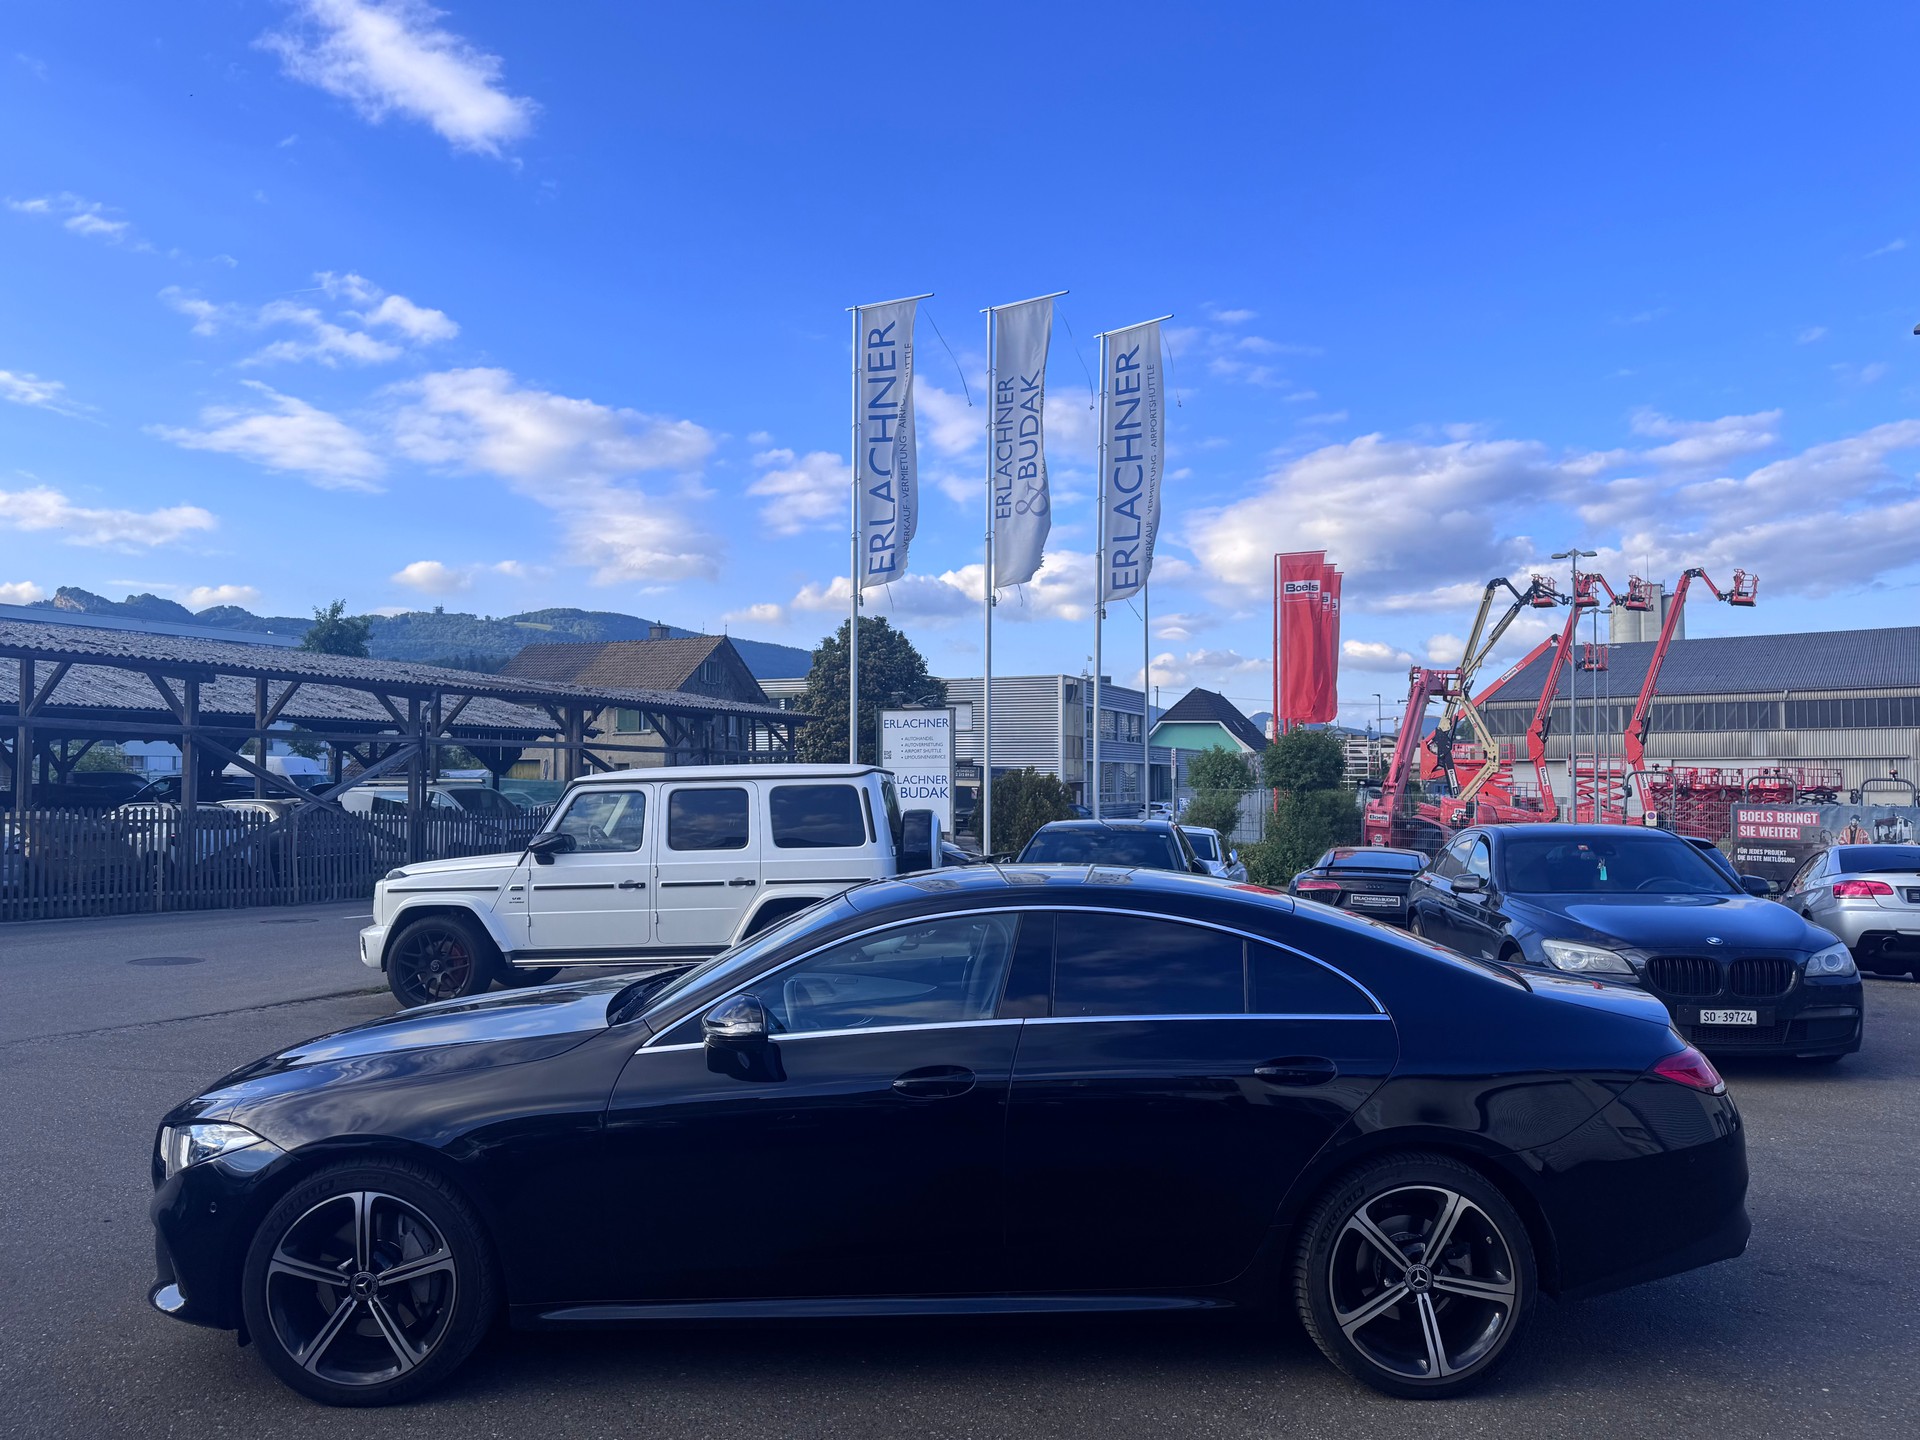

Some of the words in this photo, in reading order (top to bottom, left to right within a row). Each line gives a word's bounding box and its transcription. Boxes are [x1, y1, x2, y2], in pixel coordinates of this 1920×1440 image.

[1017, 368, 1041, 480] BUDAK
[1146, 363, 1157, 447] AIRPORTSHUTTLE
[867, 320, 898, 575] ERLACHNER
[899, 435, 909, 498] VERMIETUNG
[995, 375, 1015, 520] ERLACHNER
[1111, 343, 1144, 590] ERLACHNER
[1014, 477, 1050, 518] &
[1147, 454, 1157, 516] VERMIETUNG
[901, 504, 911, 551] VERKAUF
[1144, 521, 1154, 562] VERKAUF
[1286, 582, 1319, 592] Boels
[884, 718, 949, 729] ERLACHNER
[900, 787, 949, 799] BUDAK
[1739, 811, 1774, 823] BOELS
[1776, 812, 1818, 824] BRINGT
[1739, 825, 1757, 837] SIE
[1759, 826, 1799, 838] WEITER
[1737, 846, 1748, 854] FÜR
[1763, 855, 1796, 863] MIETLÖSUNG
